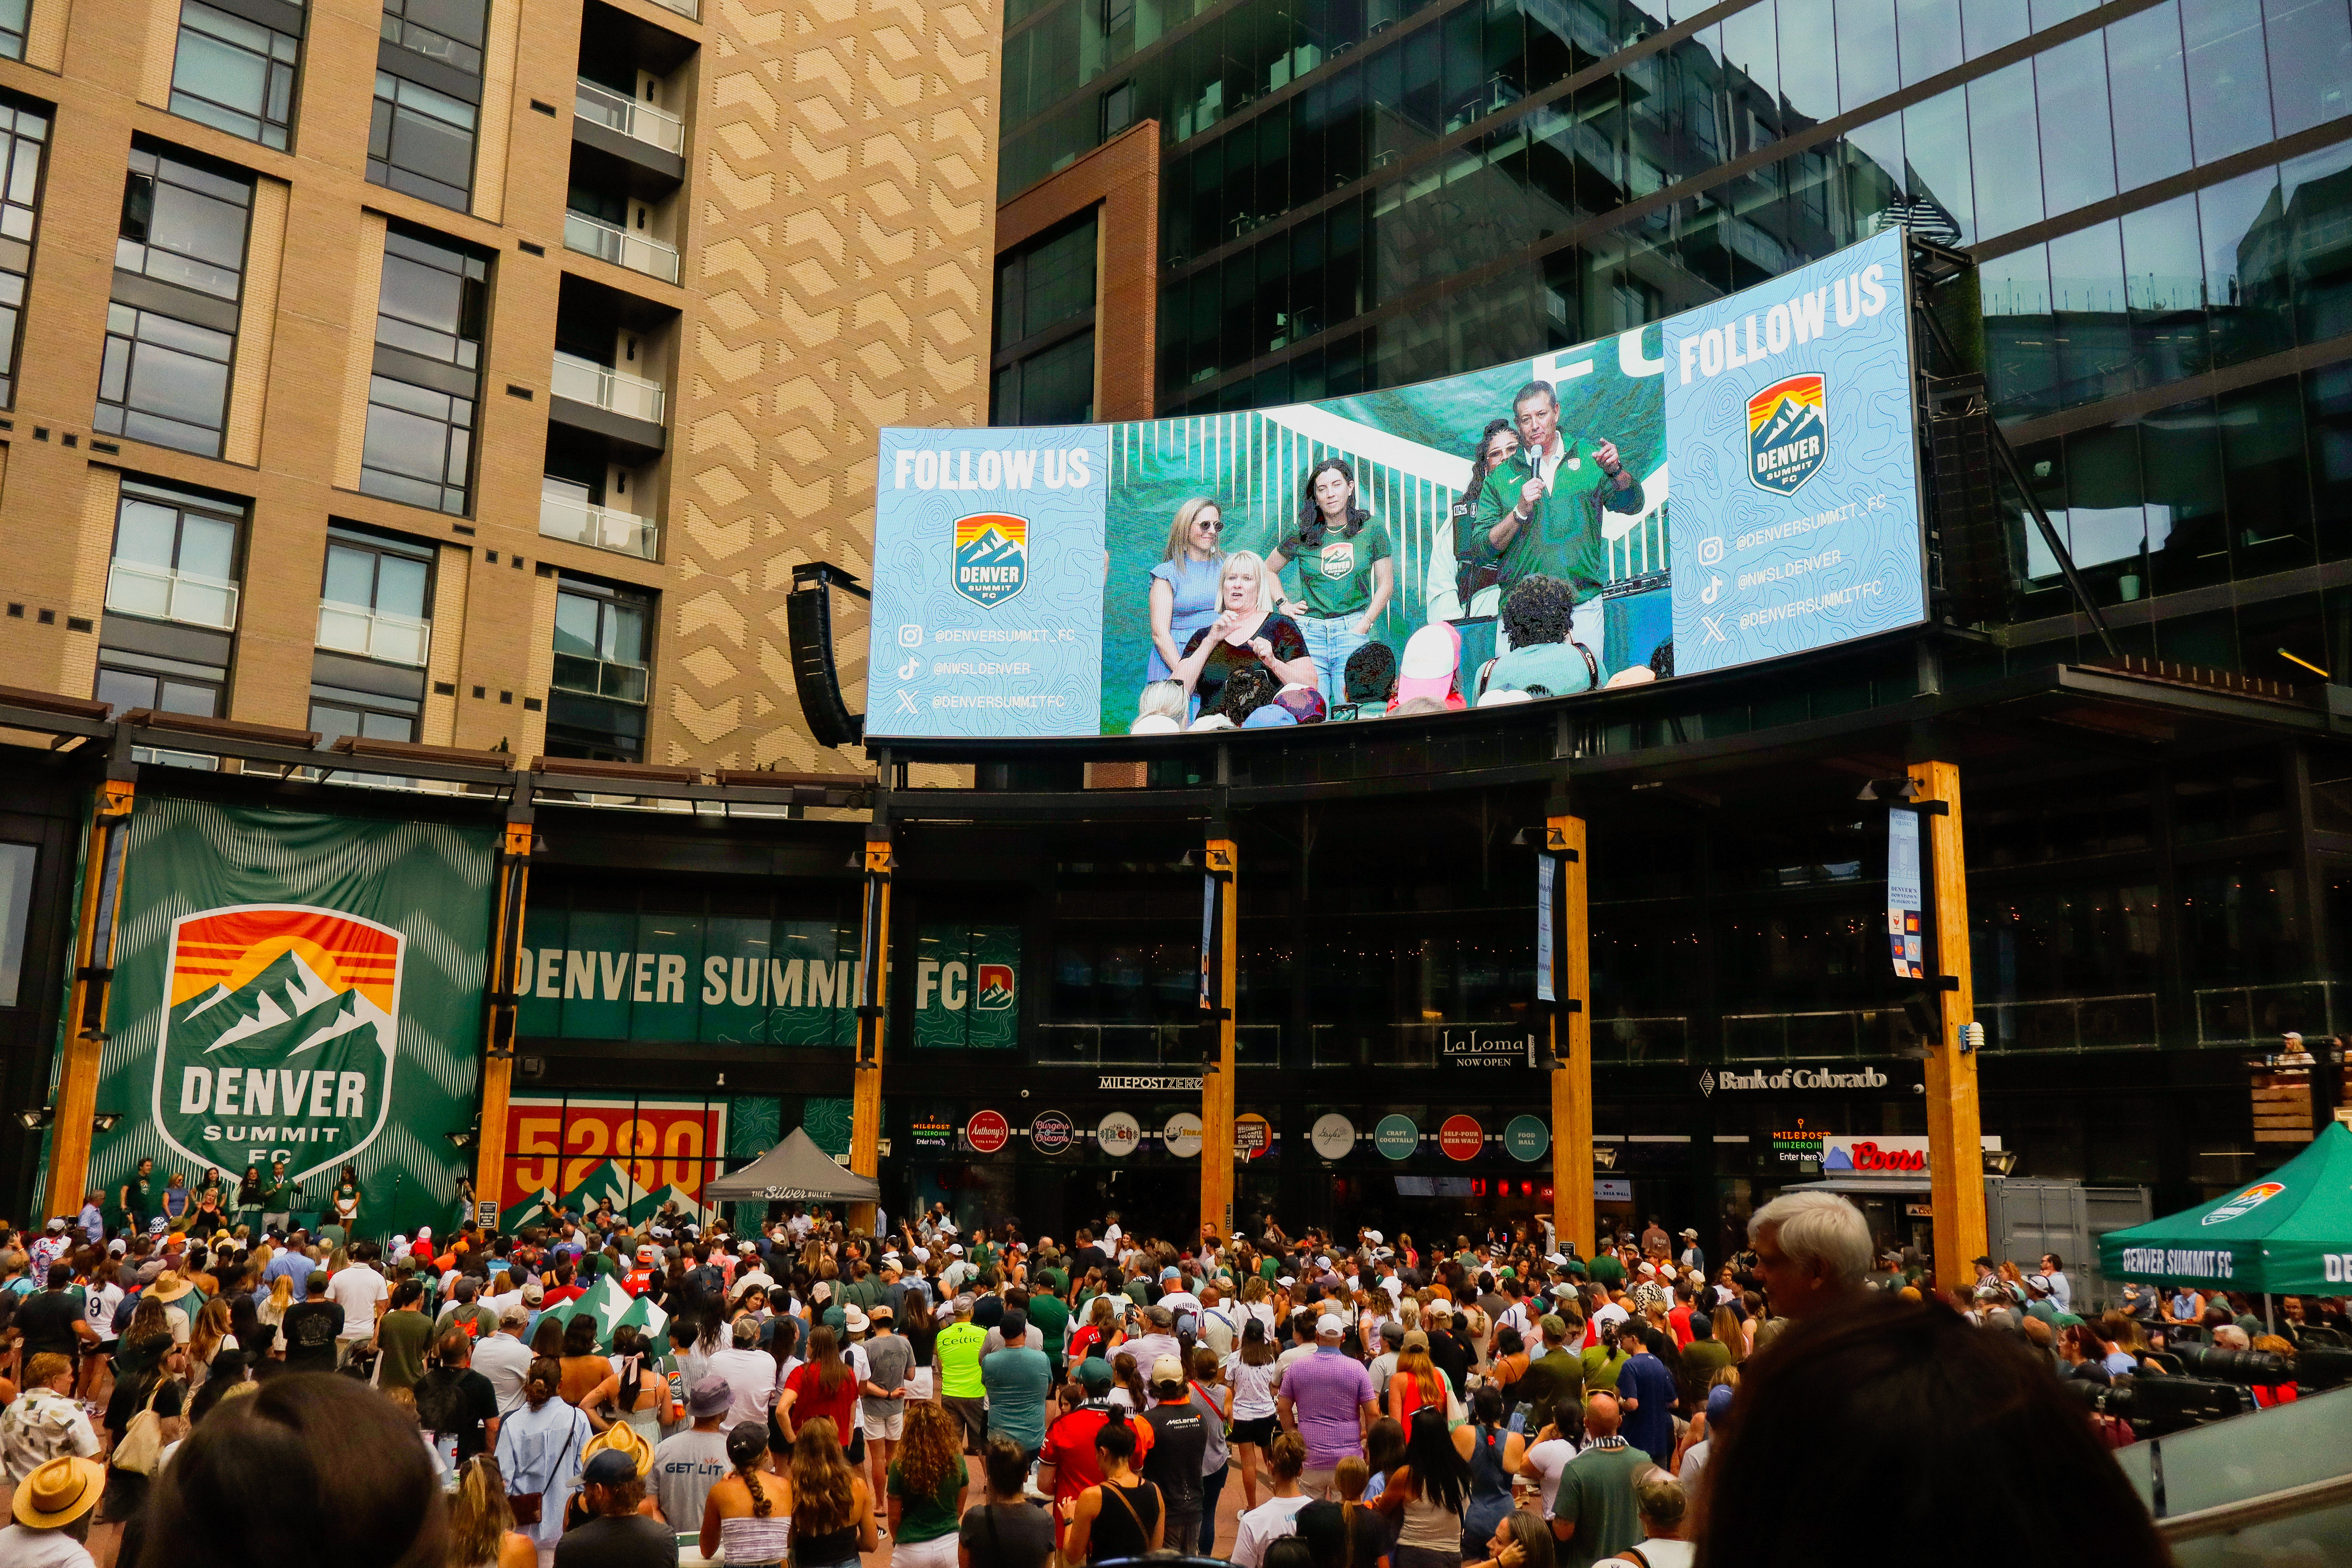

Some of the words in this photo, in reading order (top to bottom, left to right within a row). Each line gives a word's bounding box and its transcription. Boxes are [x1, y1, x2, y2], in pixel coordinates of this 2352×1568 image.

[1679, 286, 1827, 386] FOLLOW
[1834, 263, 1887, 328] US
[1757, 436, 1820, 473] DENVER
[895, 450, 1037, 490] FOLLOW
[1044, 448, 1091, 489] US
[1766, 459, 1813, 481] SUMMIT
[1782, 474, 1797, 485] FC
[1737, 493, 1887, 552] @DENVERSUMMIT_FC
[1325, 561, 1350, 571] DENVER
[1738, 549, 1842, 591] @NWSLDENVER
[960, 566, 1019, 583] DENVER
[1740, 580, 1882, 630] @DENVERSUMMITFC
[936, 628, 1075, 644] @DENVERSUMMIT_FC
[934, 662, 1031, 675] @NWSLDENVER
[933, 695, 1065, 709] @DENVERSUMMITFC
[702, 955, 892, 1009] SUMMI
[917, 961, 967, 1010] FC
[1443, 1029, 1466, 1052] La
[1470, 1029, 1524, 1052] Loma
[1483, 1058, 1511, 1066] OPEN
[1099, 1077, 1165, 1089] MILEPOST
[1720, 1069, 1769, 1090] Bank
[1769, 1068, 1792, 1089] of
[1793, 1066, 1888, 1089] Colorado
[179, 1066, 367, 1118] DENVER
[203, 1126, 340, 1142] SUMMIT
[971, 1124, 1004, 1139] Anthony's
[1036, 1121, 1070, 1132] Burgers
[1035, 1133, 1069, 1142] Dreams
[1238, 1131, 1263, 1139] COLORFUL
[248, 1149, 292, 1166] FC
[517, 1117, 704, 1194] 5280
[1780, 1152, 1800, 1161] Enter
[1801, 1152, 1818, 1161] here
[1851, 1142, 1927, 1171] Coors
[765, 1185, 807, 1199] Silver
[2123, 1248, 2165, 1274] DENVER
[2167, 1249, 2215, 1277] SUMMIT
[2217, 1251, 2233, 1279] FC
[90, 1297, 102, 1317] 9
[942, 1336, 980, 1346] Celtic
[1166, 1417, 1199, 1426] McLaren
[665, 1463, 696, 1473] GET
[698, 1464, 724, 1475] LIT
